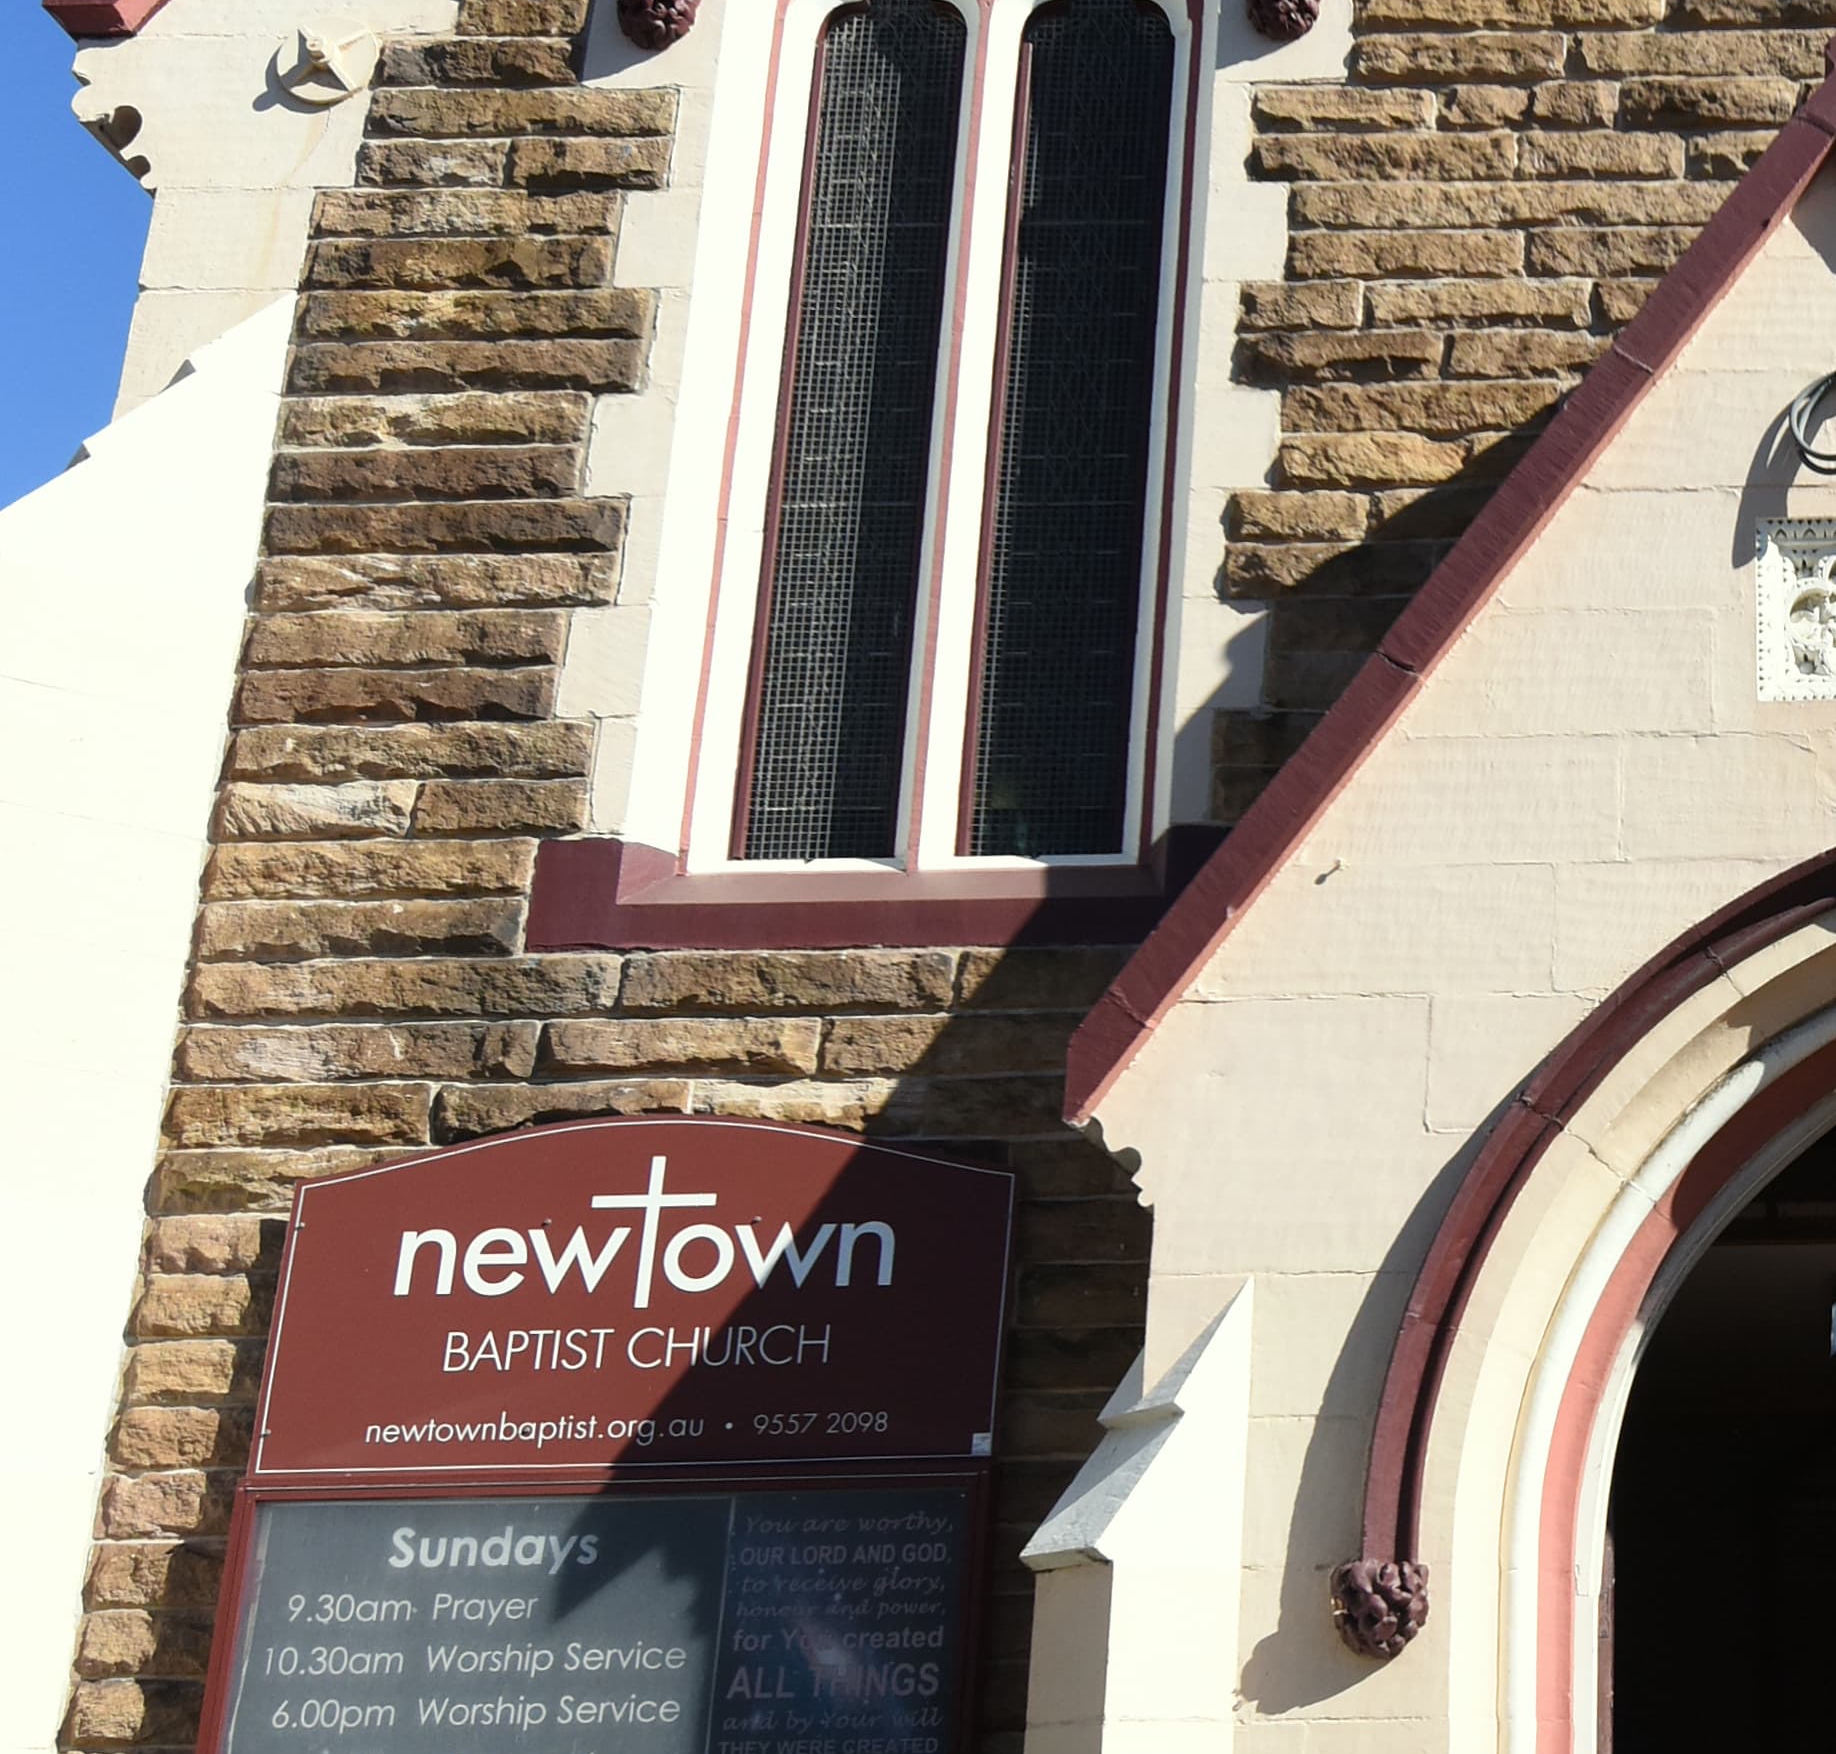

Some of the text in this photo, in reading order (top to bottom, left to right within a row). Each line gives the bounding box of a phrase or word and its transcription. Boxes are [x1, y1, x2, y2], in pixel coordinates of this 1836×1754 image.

[392, 1155, 896, 1309] newtown
[442, 1324, 831, 1373] BAPTIST CHURCH
[364, 1410, 889, 1448] newtownbaptist.org.au 9557 2098
[745, 1515, 793, 1534] You
[803, 1518, 849, 1533] are
[388, 1526, 599, 1574] Sundays
[740, 1546, 784, 1566] OUR
[790, 1545, 847, 1565] LORD
[852, 1544, 896, 1564] AND
[742, 1575, 766, 1592] to
[774, 1574, 867, 1592] receive
[287, 1593, 539, 1627] 9.30am Prayer
[825, 1599, 873, 1616] and
[733, 1629, 772, 1651] for
[842, 1625, 944, 1649] created
[263, 1642, 687, 1679] 10.30am Worship Service
[726, 1662, 940, 1700] ALL THINGS
[271, 1696, 680, 1735] 6.00pm Worship Service
[723, 1710, 778, 1731] and
[786, 1710, 813, 1734] by
[891, 1707, 943, 1727] will
[842, 1737, 938, 1754] CREATED
